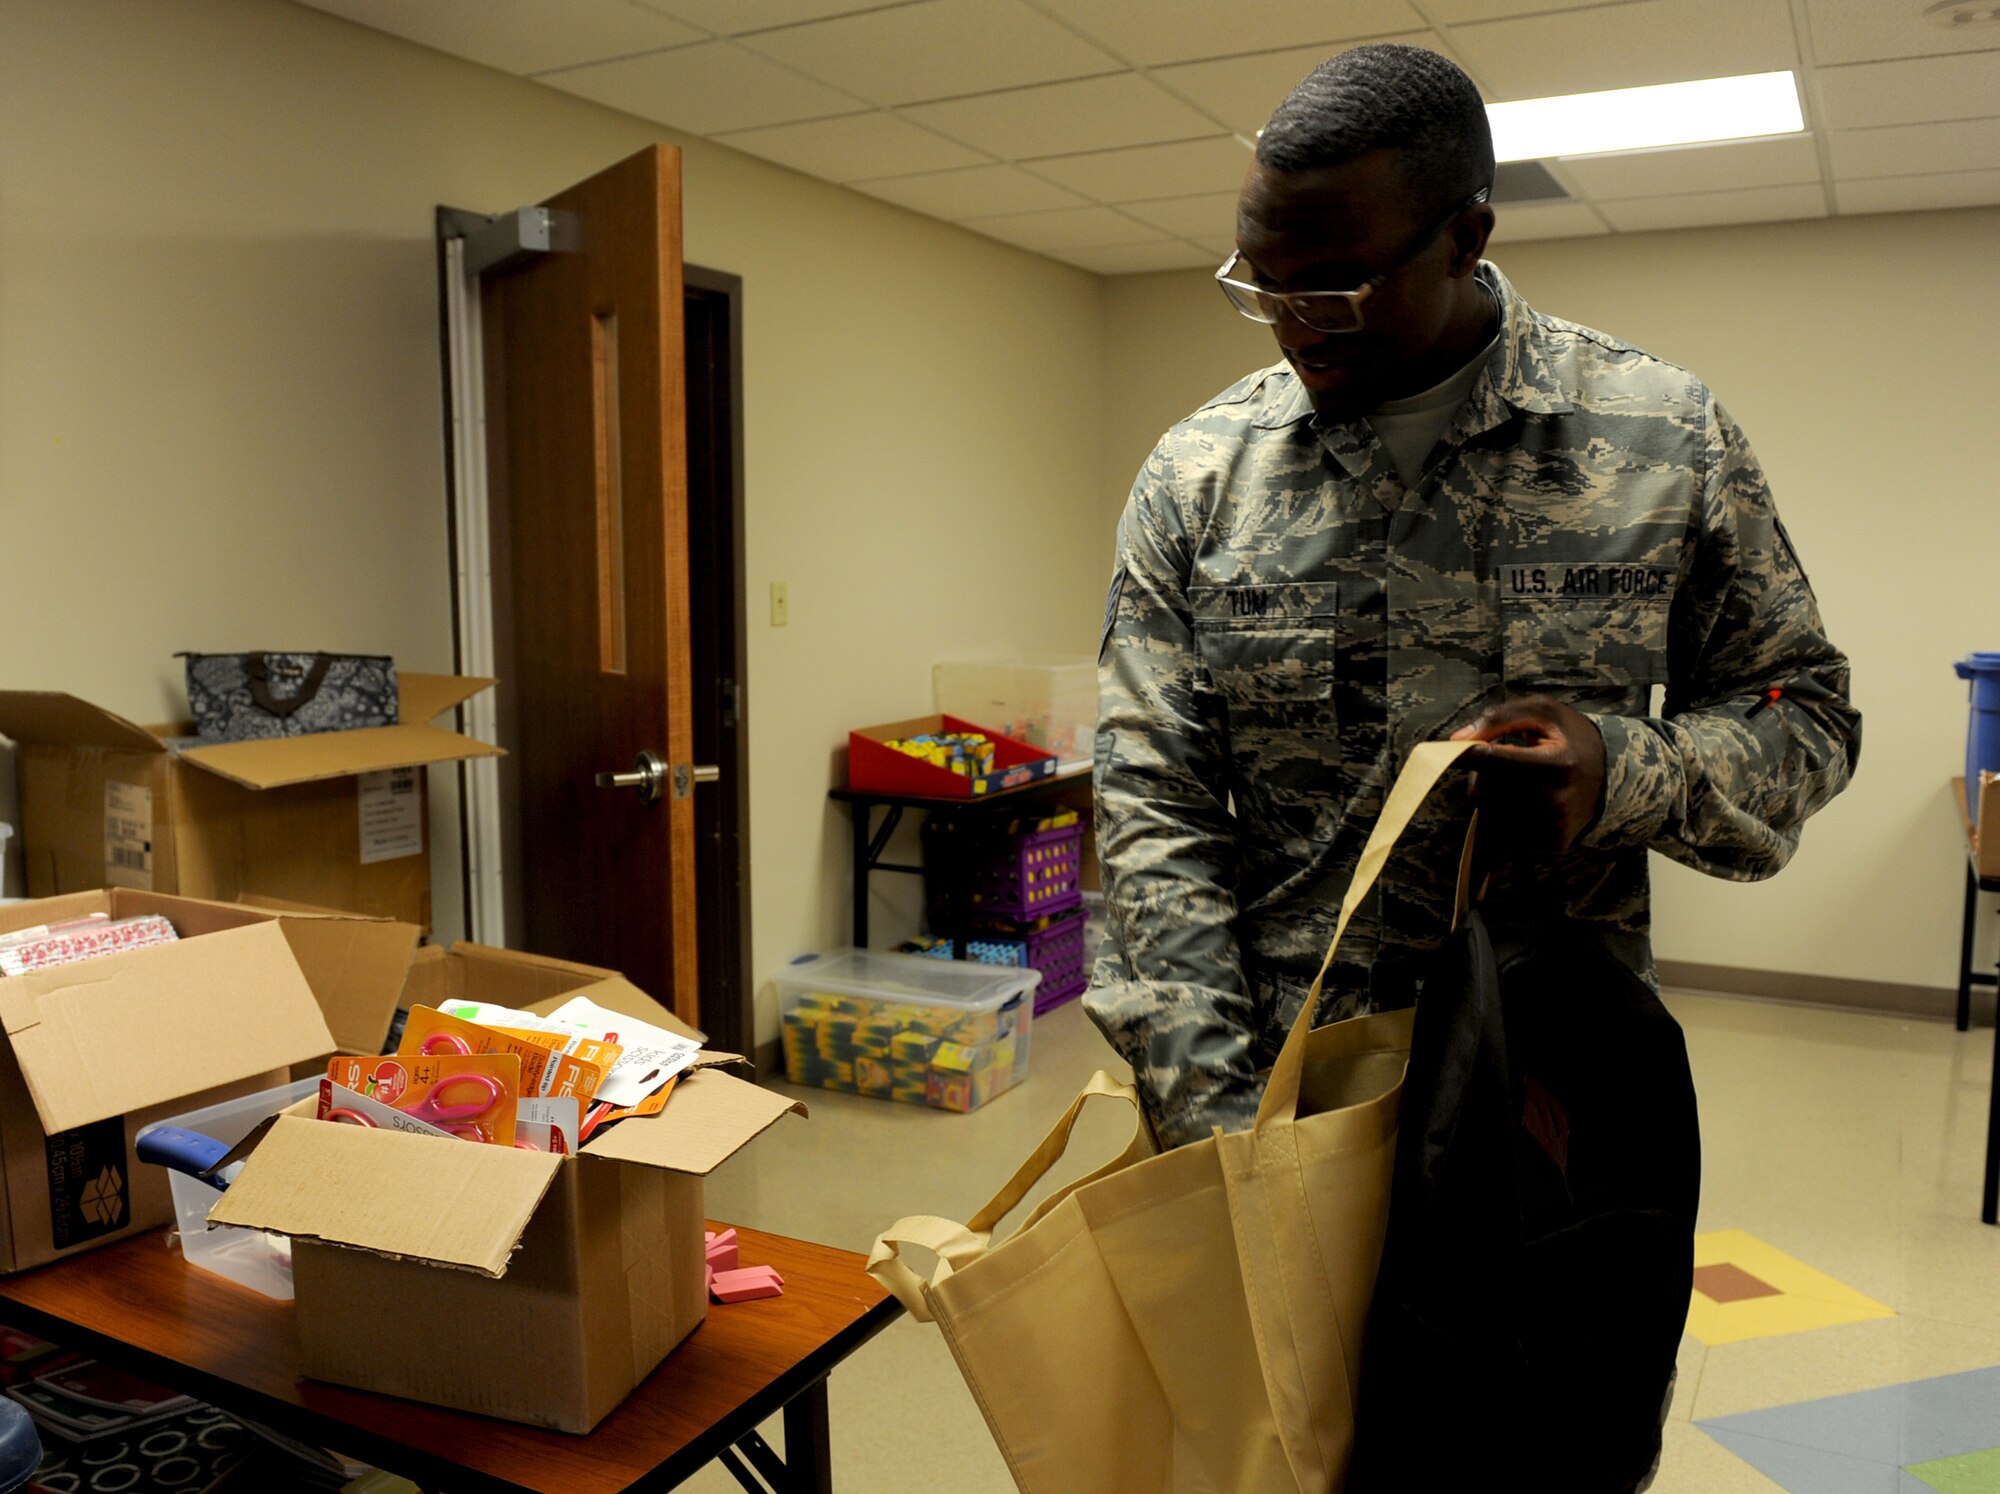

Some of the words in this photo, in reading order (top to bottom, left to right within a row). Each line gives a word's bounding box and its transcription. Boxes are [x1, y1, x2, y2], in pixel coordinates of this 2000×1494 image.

[1512, 569, 1552, 594] U.S.
[1563, 568, 1599, 595] AIR
[1608, 568, 1672, 595] FORCE
[1226, 589, 1267, 615] TUM
[634, 1049, 666, 1066] kids
[421, 1066, 431, 1084] 4+
[378, 1077, 393, 1094] #1
